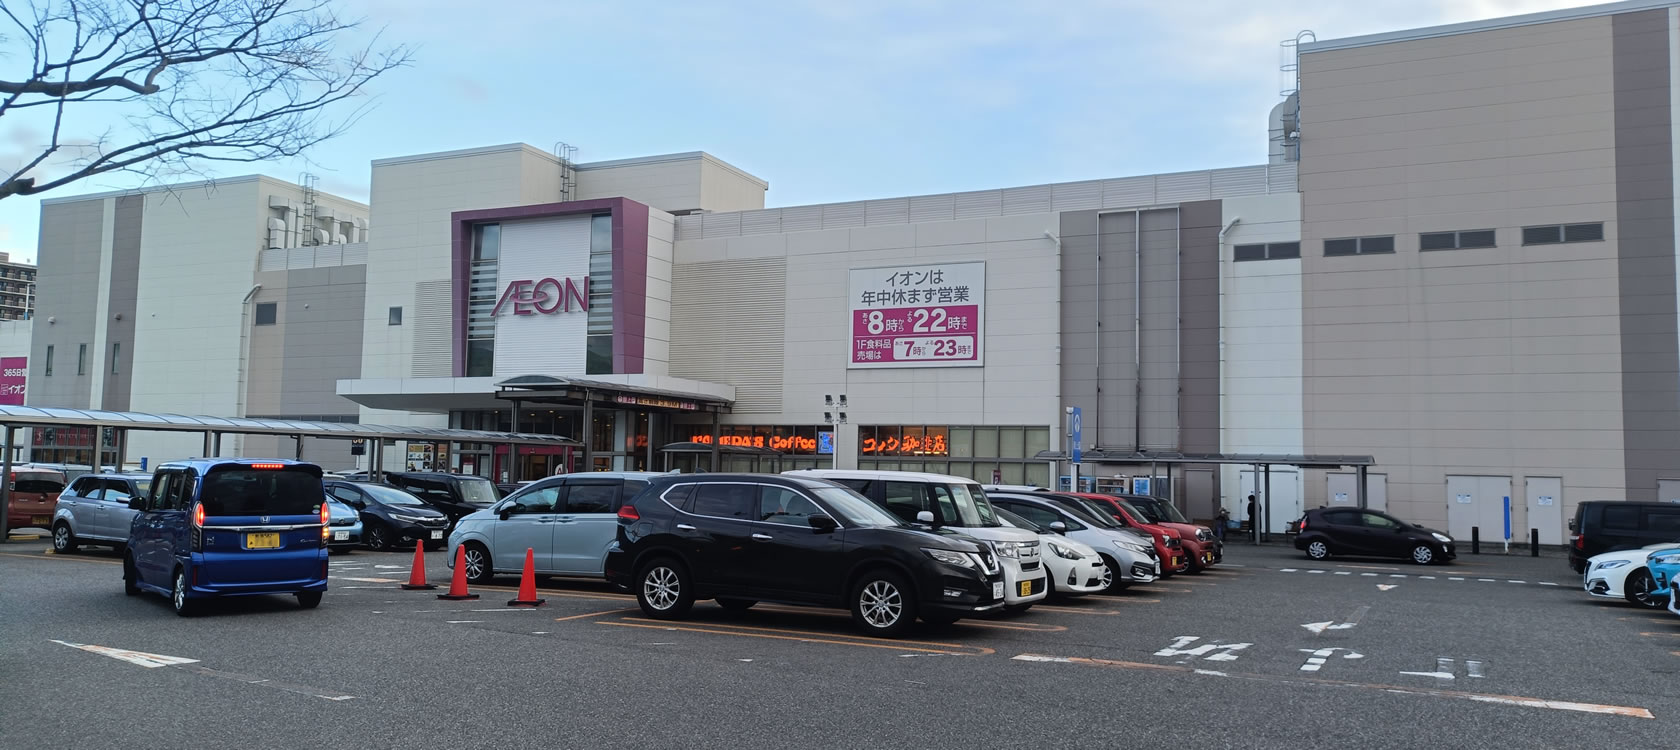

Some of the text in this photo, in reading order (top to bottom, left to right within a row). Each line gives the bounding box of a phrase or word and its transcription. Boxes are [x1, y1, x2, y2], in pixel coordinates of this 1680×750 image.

[886, 269, 944, 287] イオンは
[861, 285, 970, 307] 年中休まず営業
